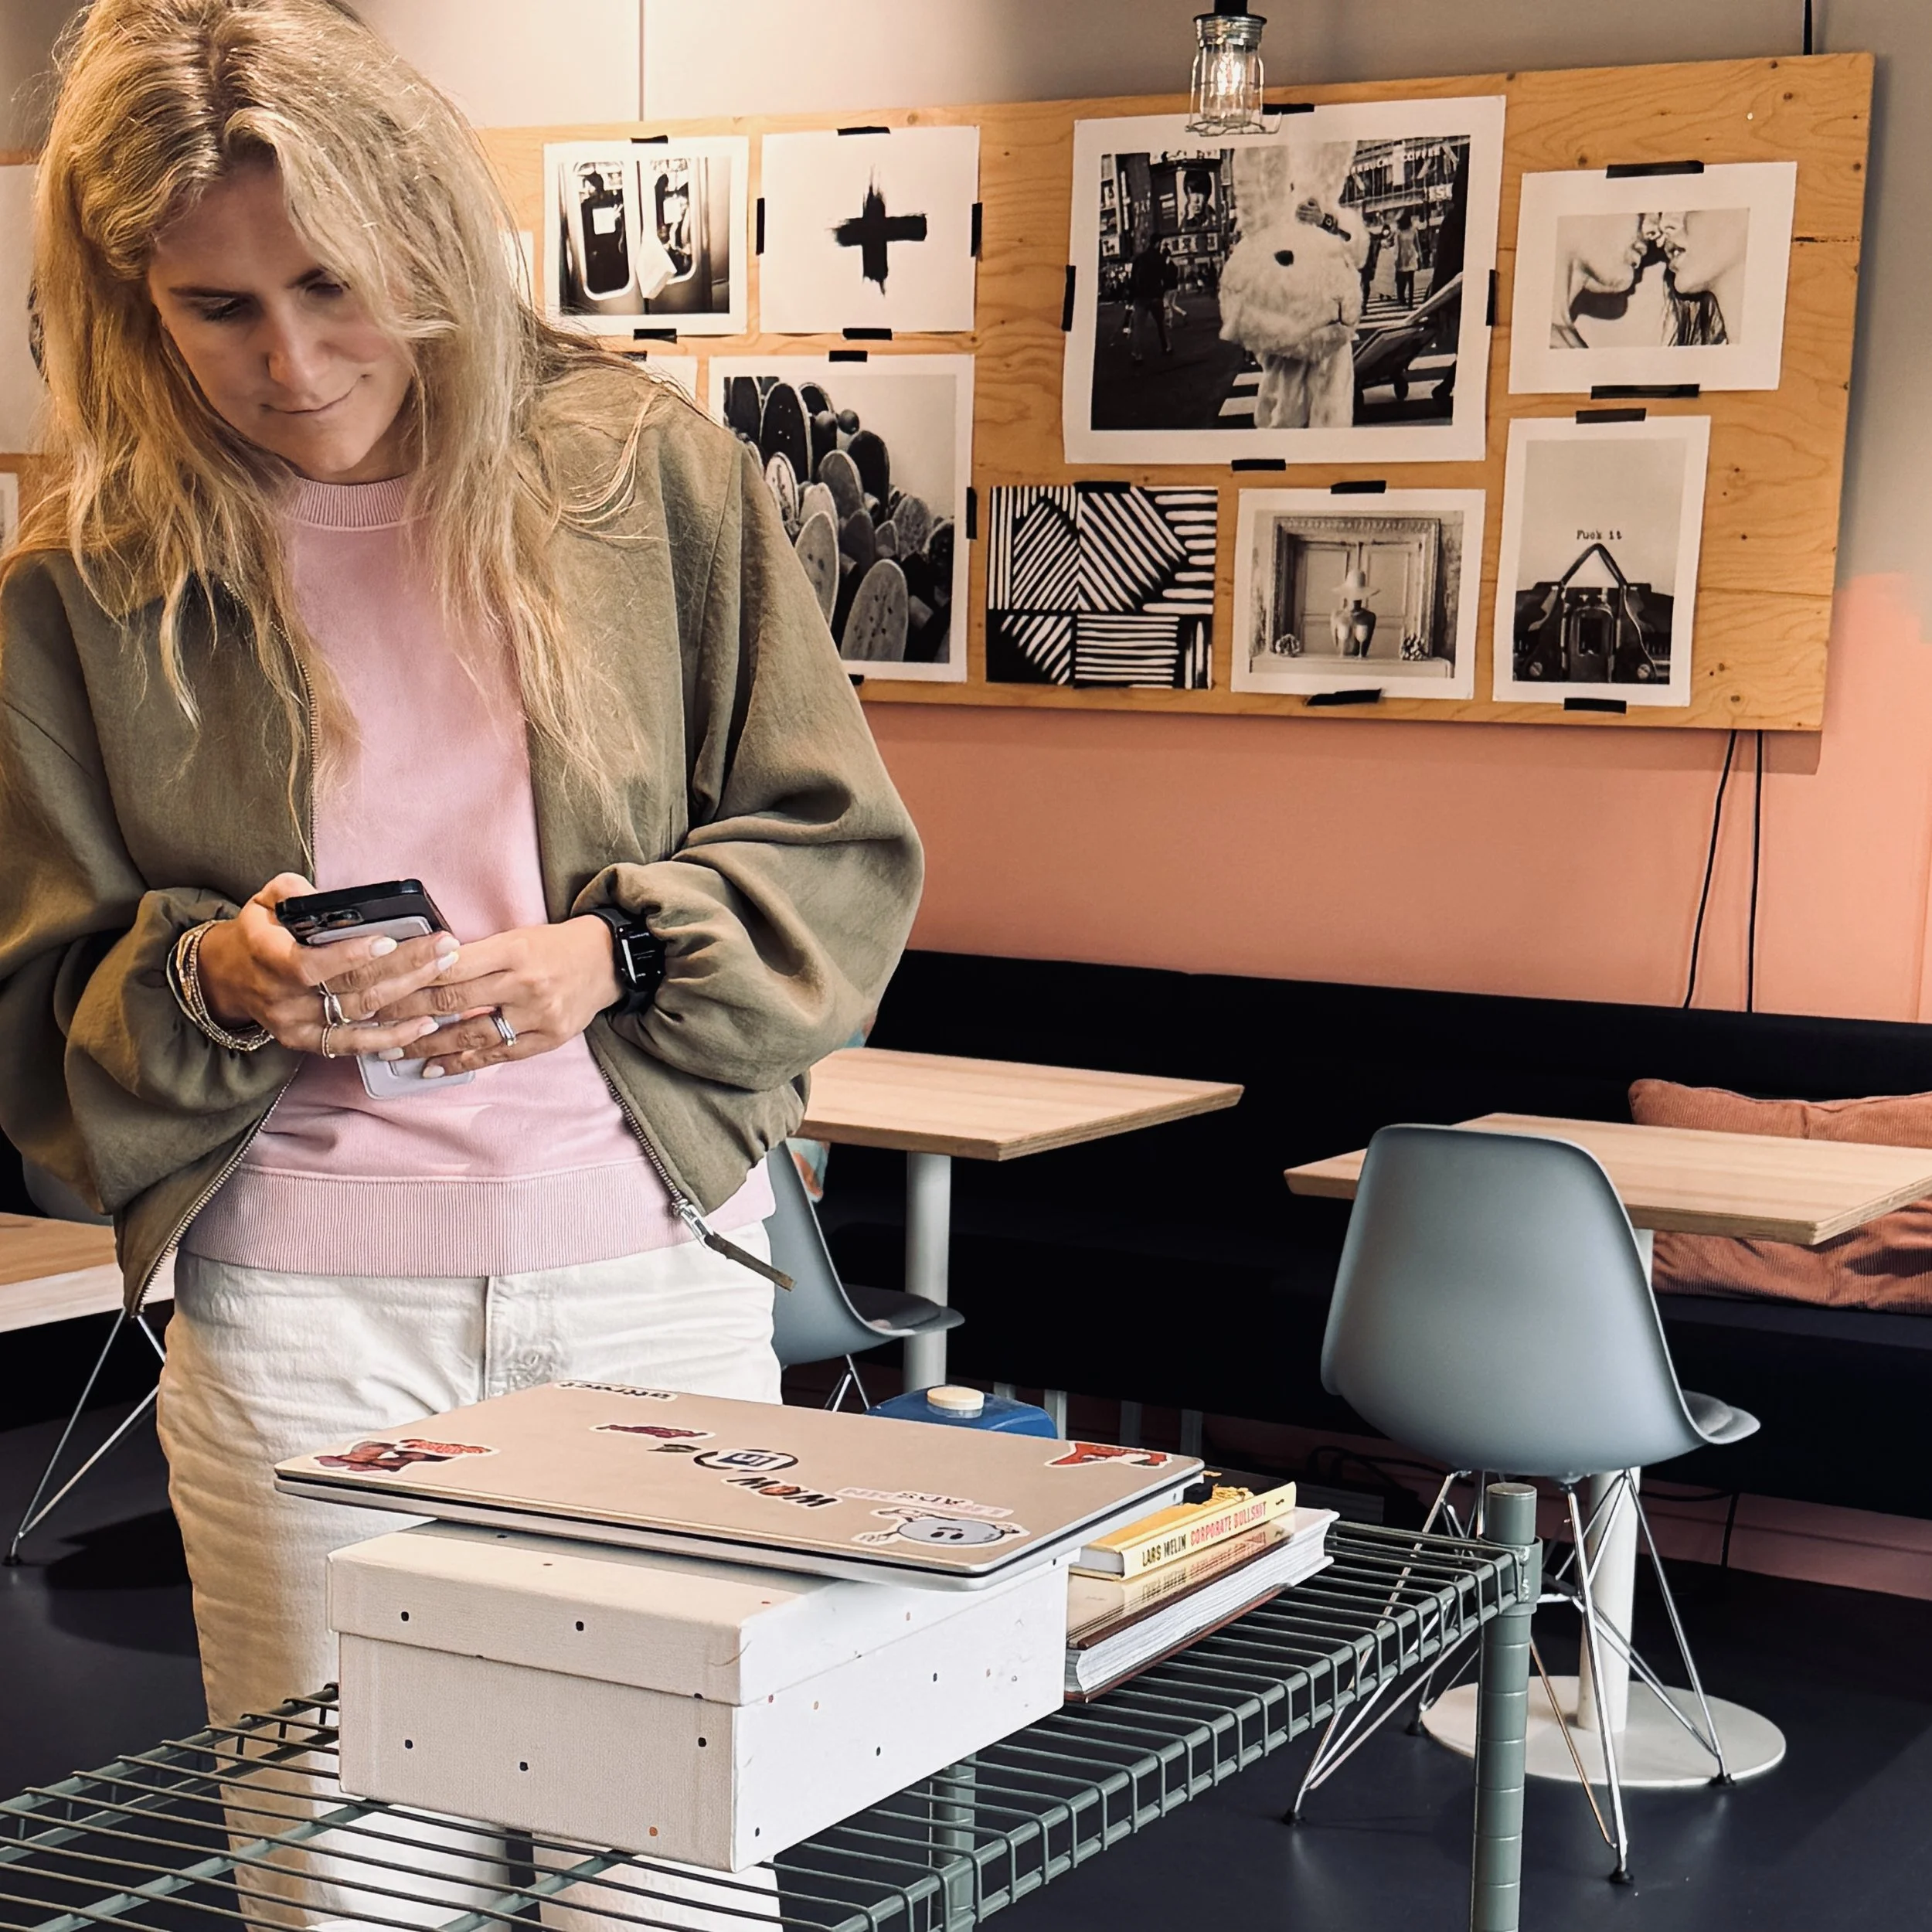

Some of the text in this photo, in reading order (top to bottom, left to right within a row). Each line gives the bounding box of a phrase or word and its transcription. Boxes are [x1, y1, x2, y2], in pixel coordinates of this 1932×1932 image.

[1142, 1544, 1162, 1567] LARS
[1163, 1533, 1186, 1559] MELIN
[1190, 1515, 1232, 1546] CORPORATE
